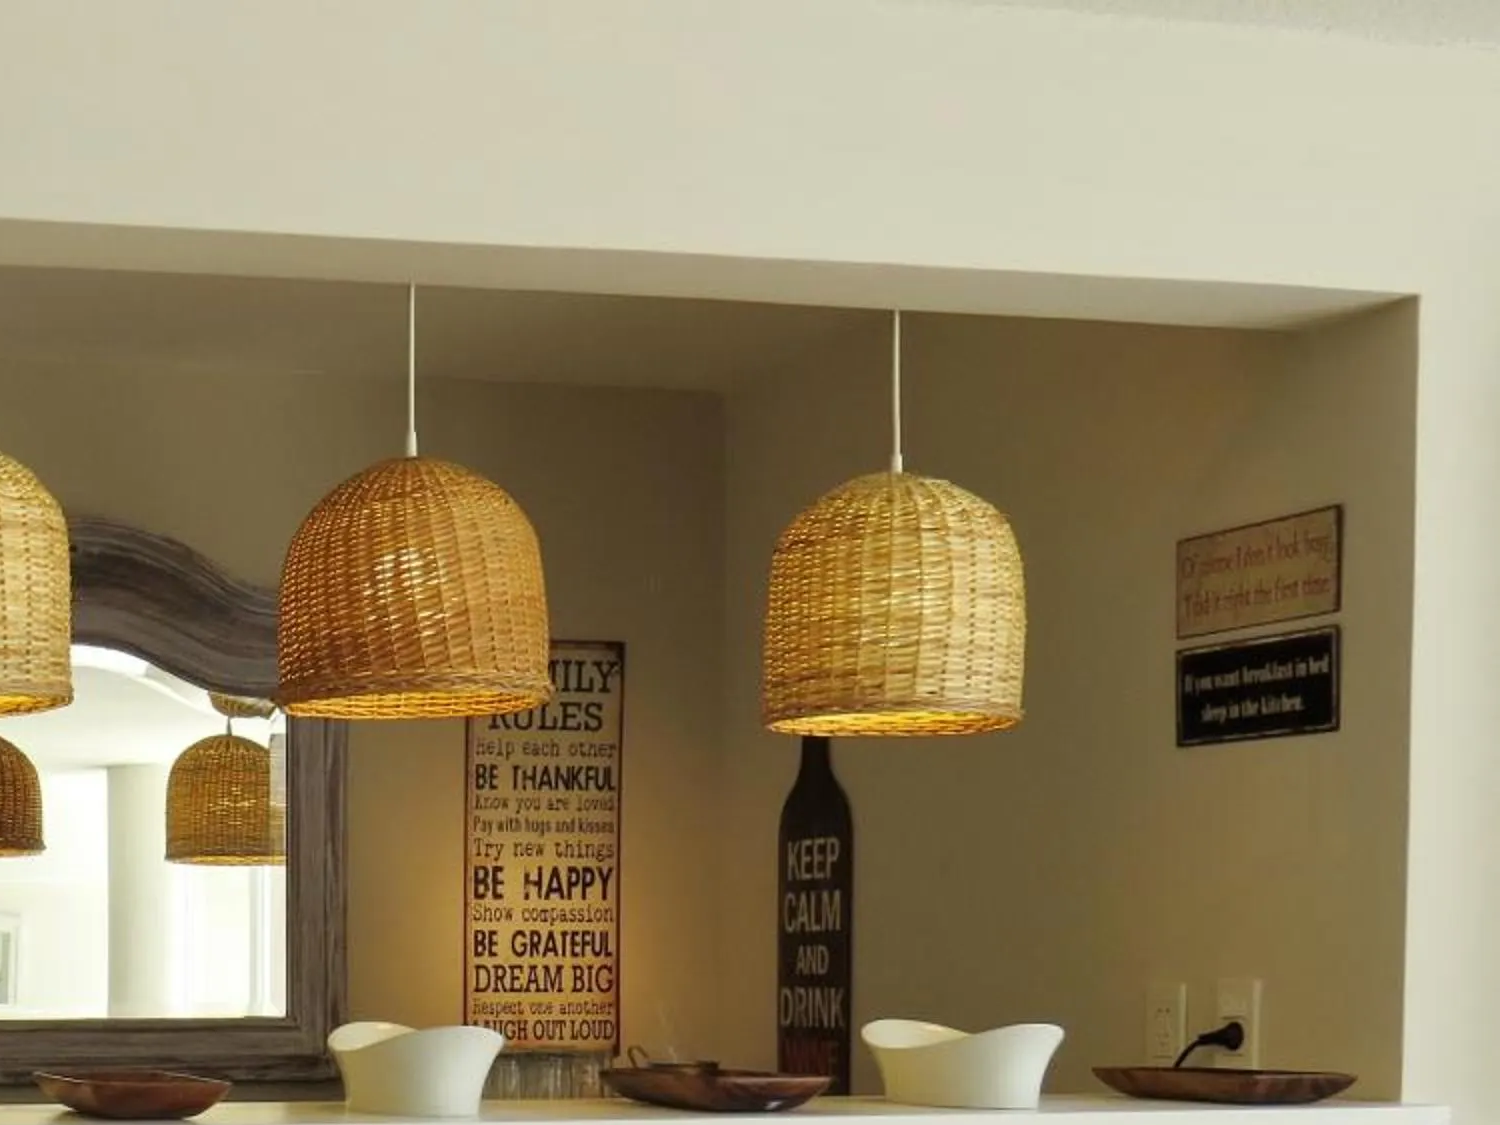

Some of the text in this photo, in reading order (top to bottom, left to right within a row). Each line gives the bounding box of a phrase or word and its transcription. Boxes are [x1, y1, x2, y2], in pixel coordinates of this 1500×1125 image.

[548, 659, 619, 693] ILY
[522, 738, 560, 757] each
[569, 739, 616, 758] other
[475, 764, 616, 791] BE THANKFUL
[516, 796, 541, 815] you
[473, 838, 614, 862] Try new things
[787, 837, 841, 882] KEEP
[473, 865, 614, 901] BE HAPPY
[473, 903, 614, 926] Show compassion
[783, 889, 842, 933] CALM
[474, 930, 613, 958] BE GRATEFUL
[795, 945, 830, 976] AND
[474, 964, 614, 993] DREAM BIG
[779, 986, 845, 1029] DRINK
[474, 1019, 615, 1040] UGH OUT LOUD
